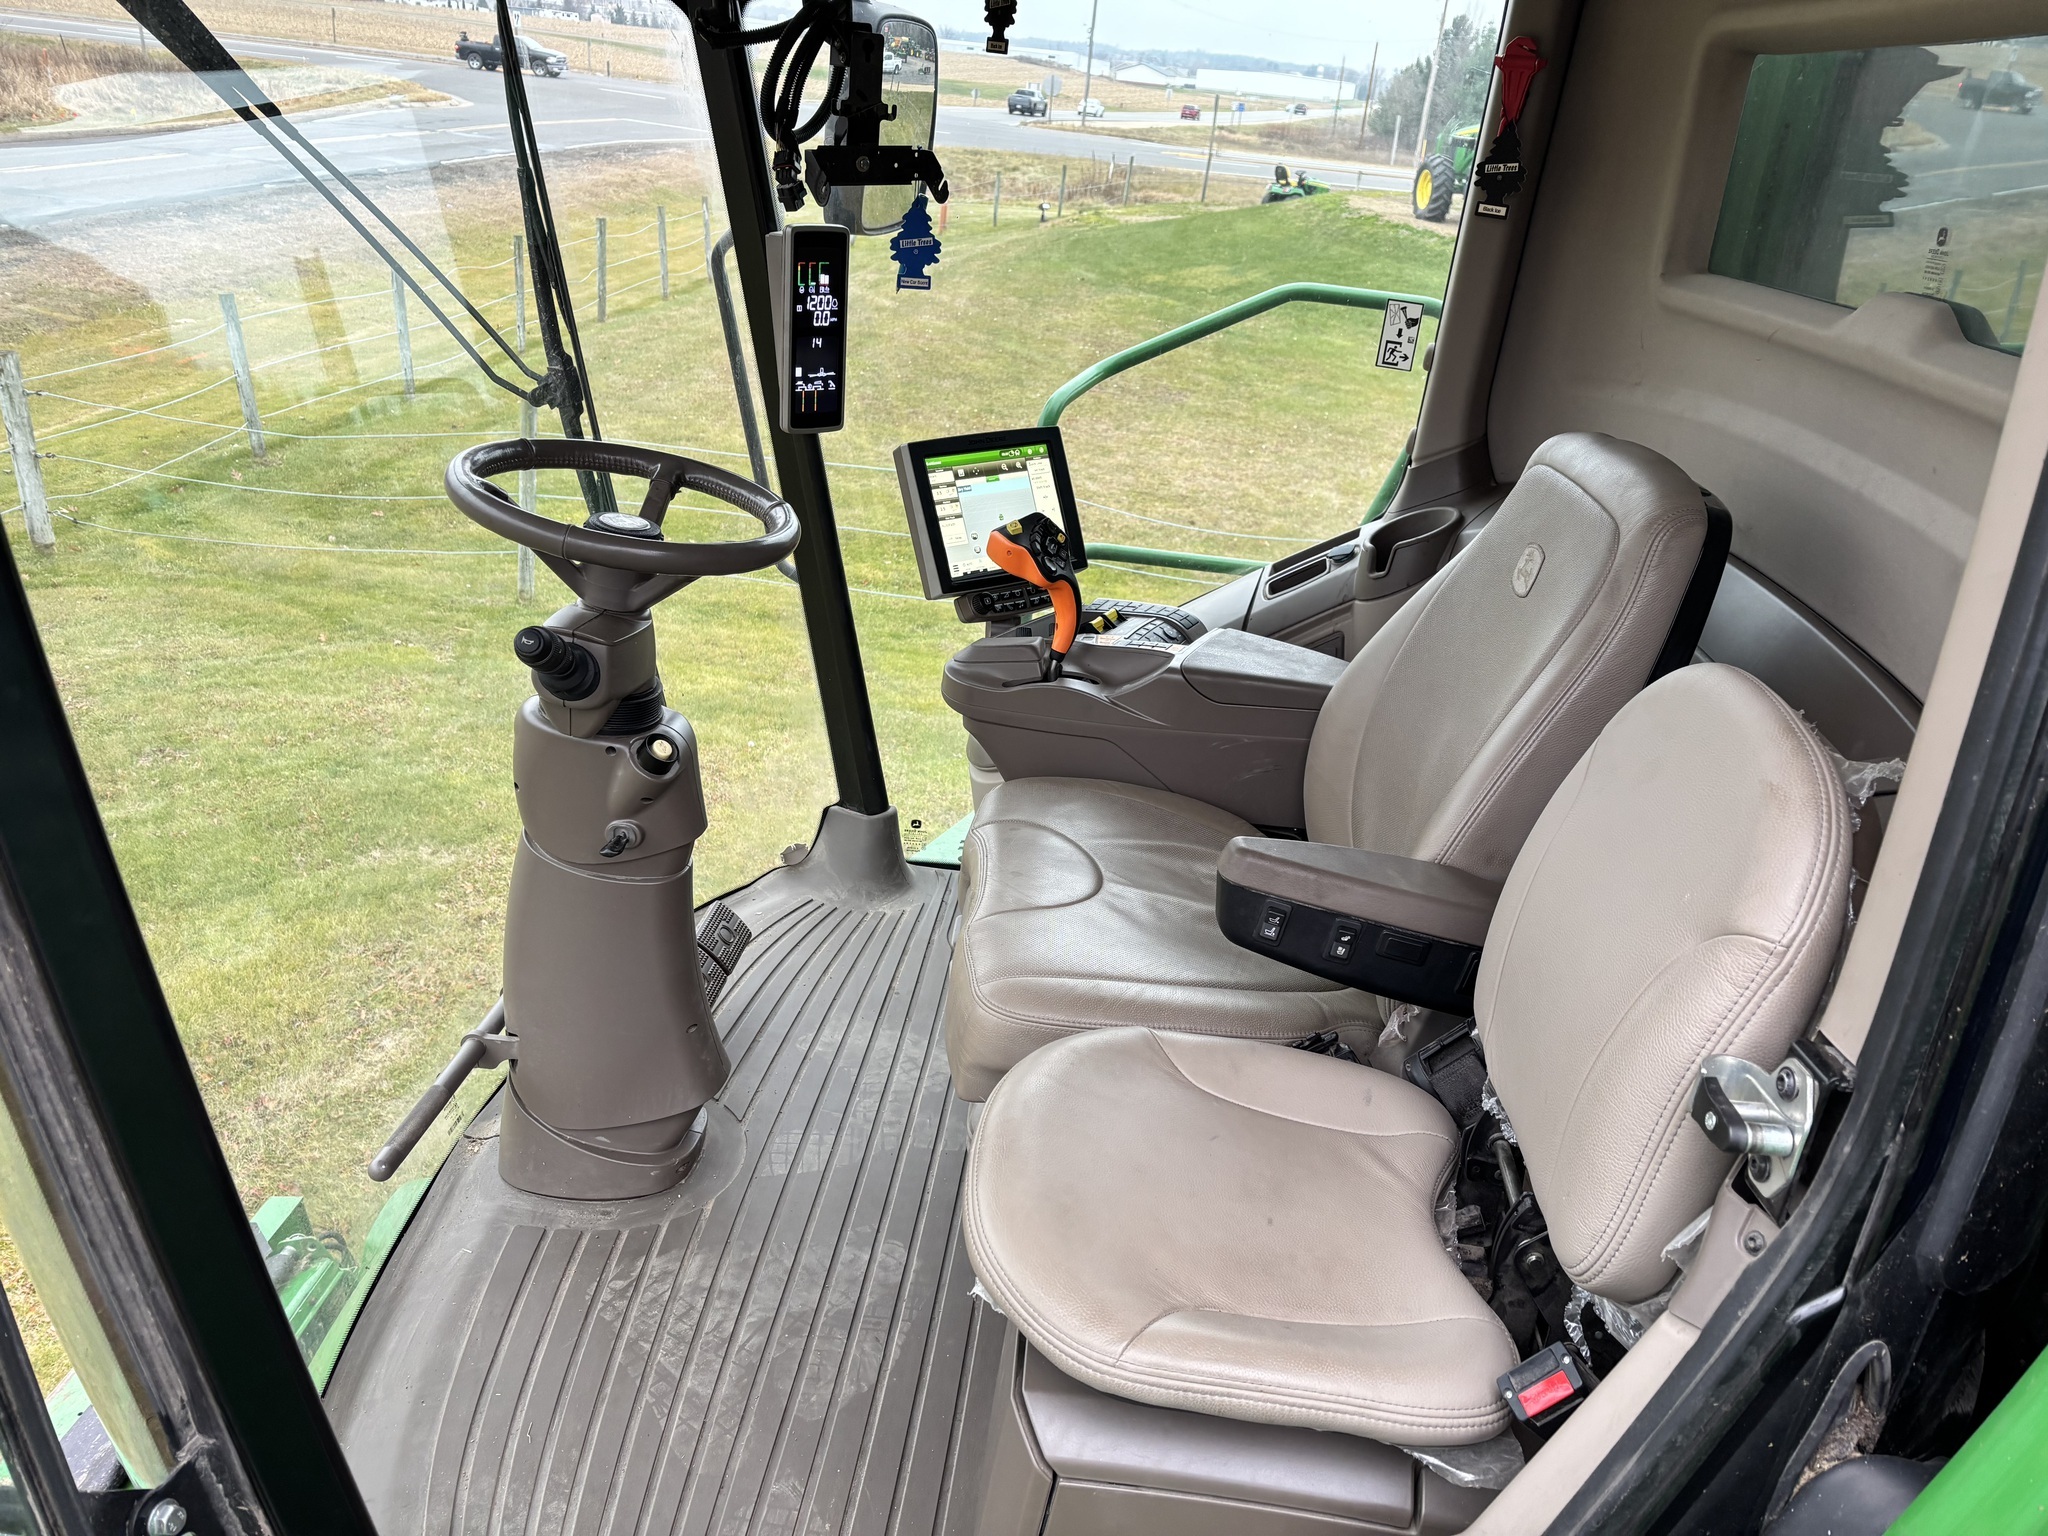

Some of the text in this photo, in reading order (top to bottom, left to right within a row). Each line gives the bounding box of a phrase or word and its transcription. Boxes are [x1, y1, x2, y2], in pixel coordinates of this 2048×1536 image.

[1486, 164, 1501, 173] Little
[1482, 205, 1494, 213] Black
[901, 239, 916, 248] Little
[806, 294, 833, 311] 1200
[813, 310, 831, 327] 0.0
[812, 337, 823, 349] 14
